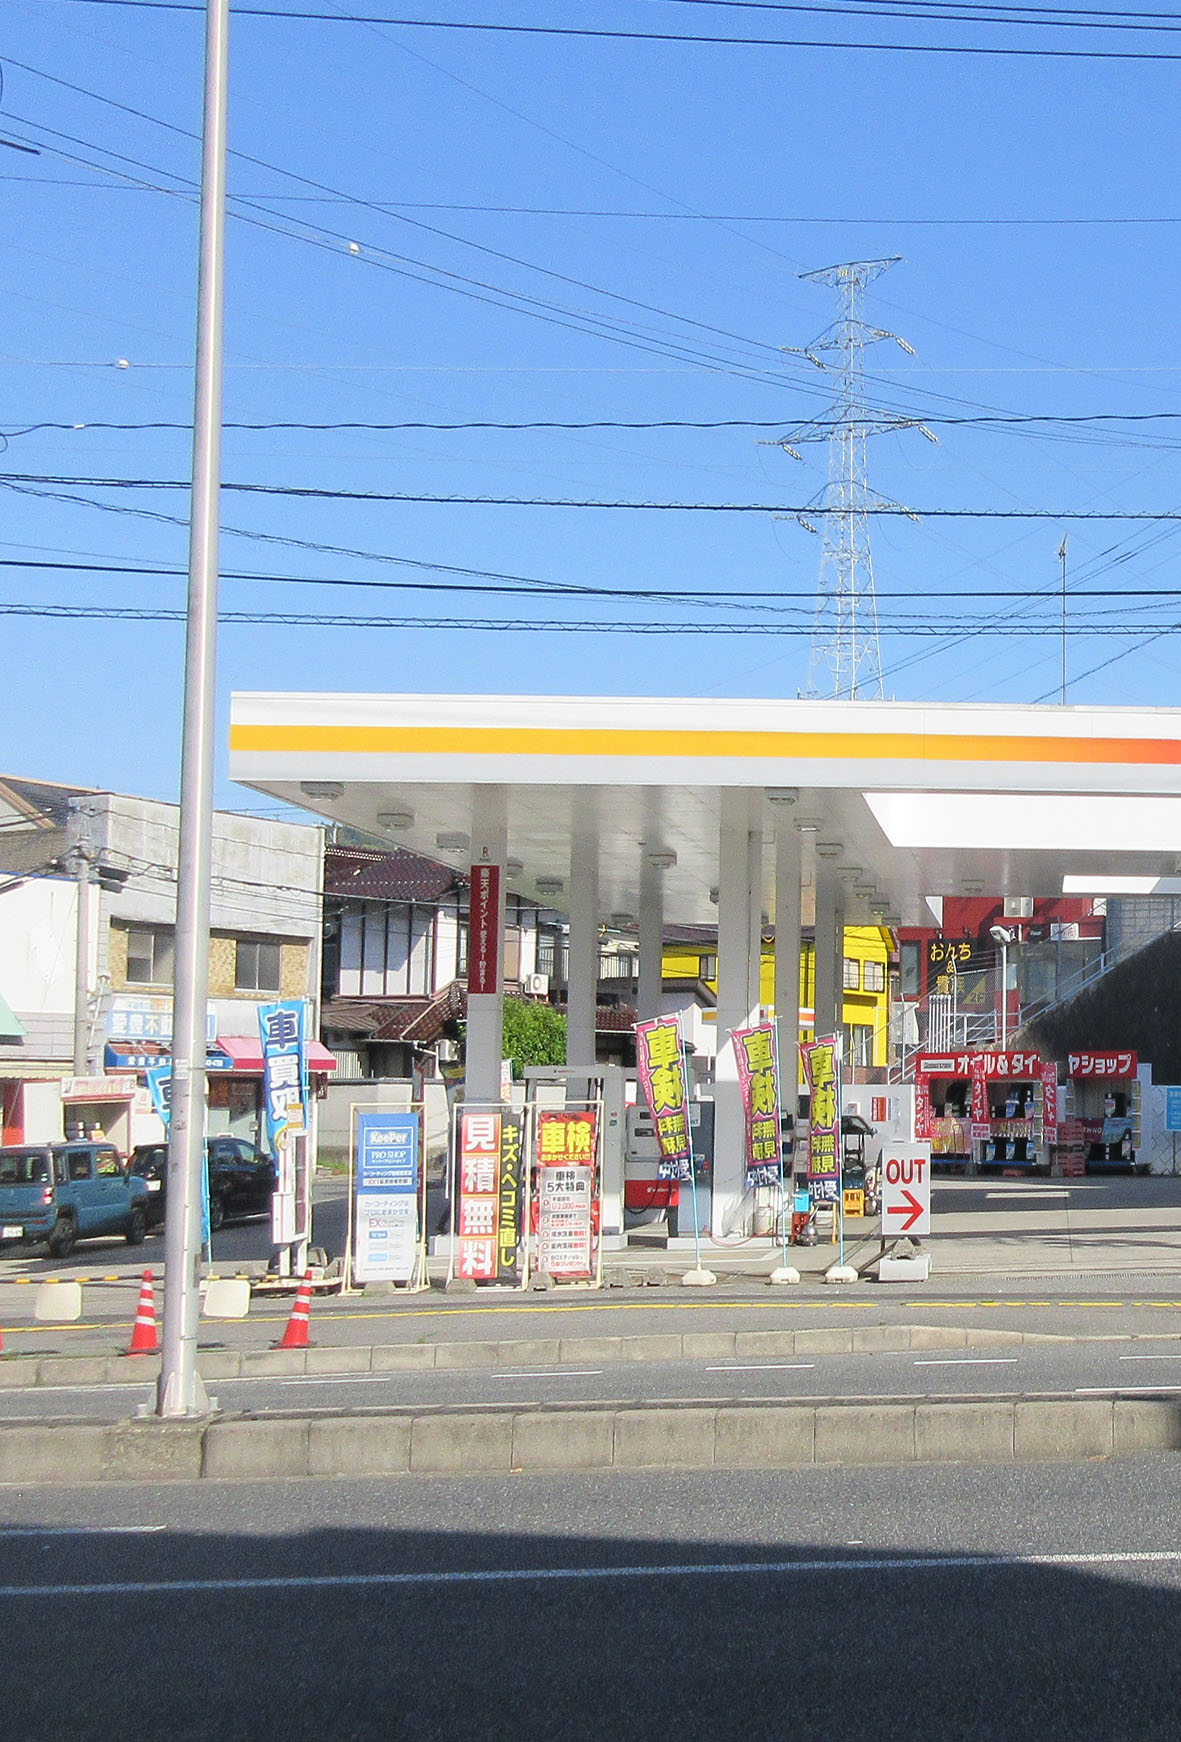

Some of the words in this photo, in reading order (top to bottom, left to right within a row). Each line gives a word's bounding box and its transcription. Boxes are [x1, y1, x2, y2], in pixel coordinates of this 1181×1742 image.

[930, 942, 972, 962] おんち
[370, 1130, 409, 1145] KeePer
[541, 1121, 591, 1154] 車検
[886, 1159, 926, 1185] OUT
[461, 1116, 496, 1276] 見積無料
[500, 1124, 518, 1267] キズ・ヘコミ直し
